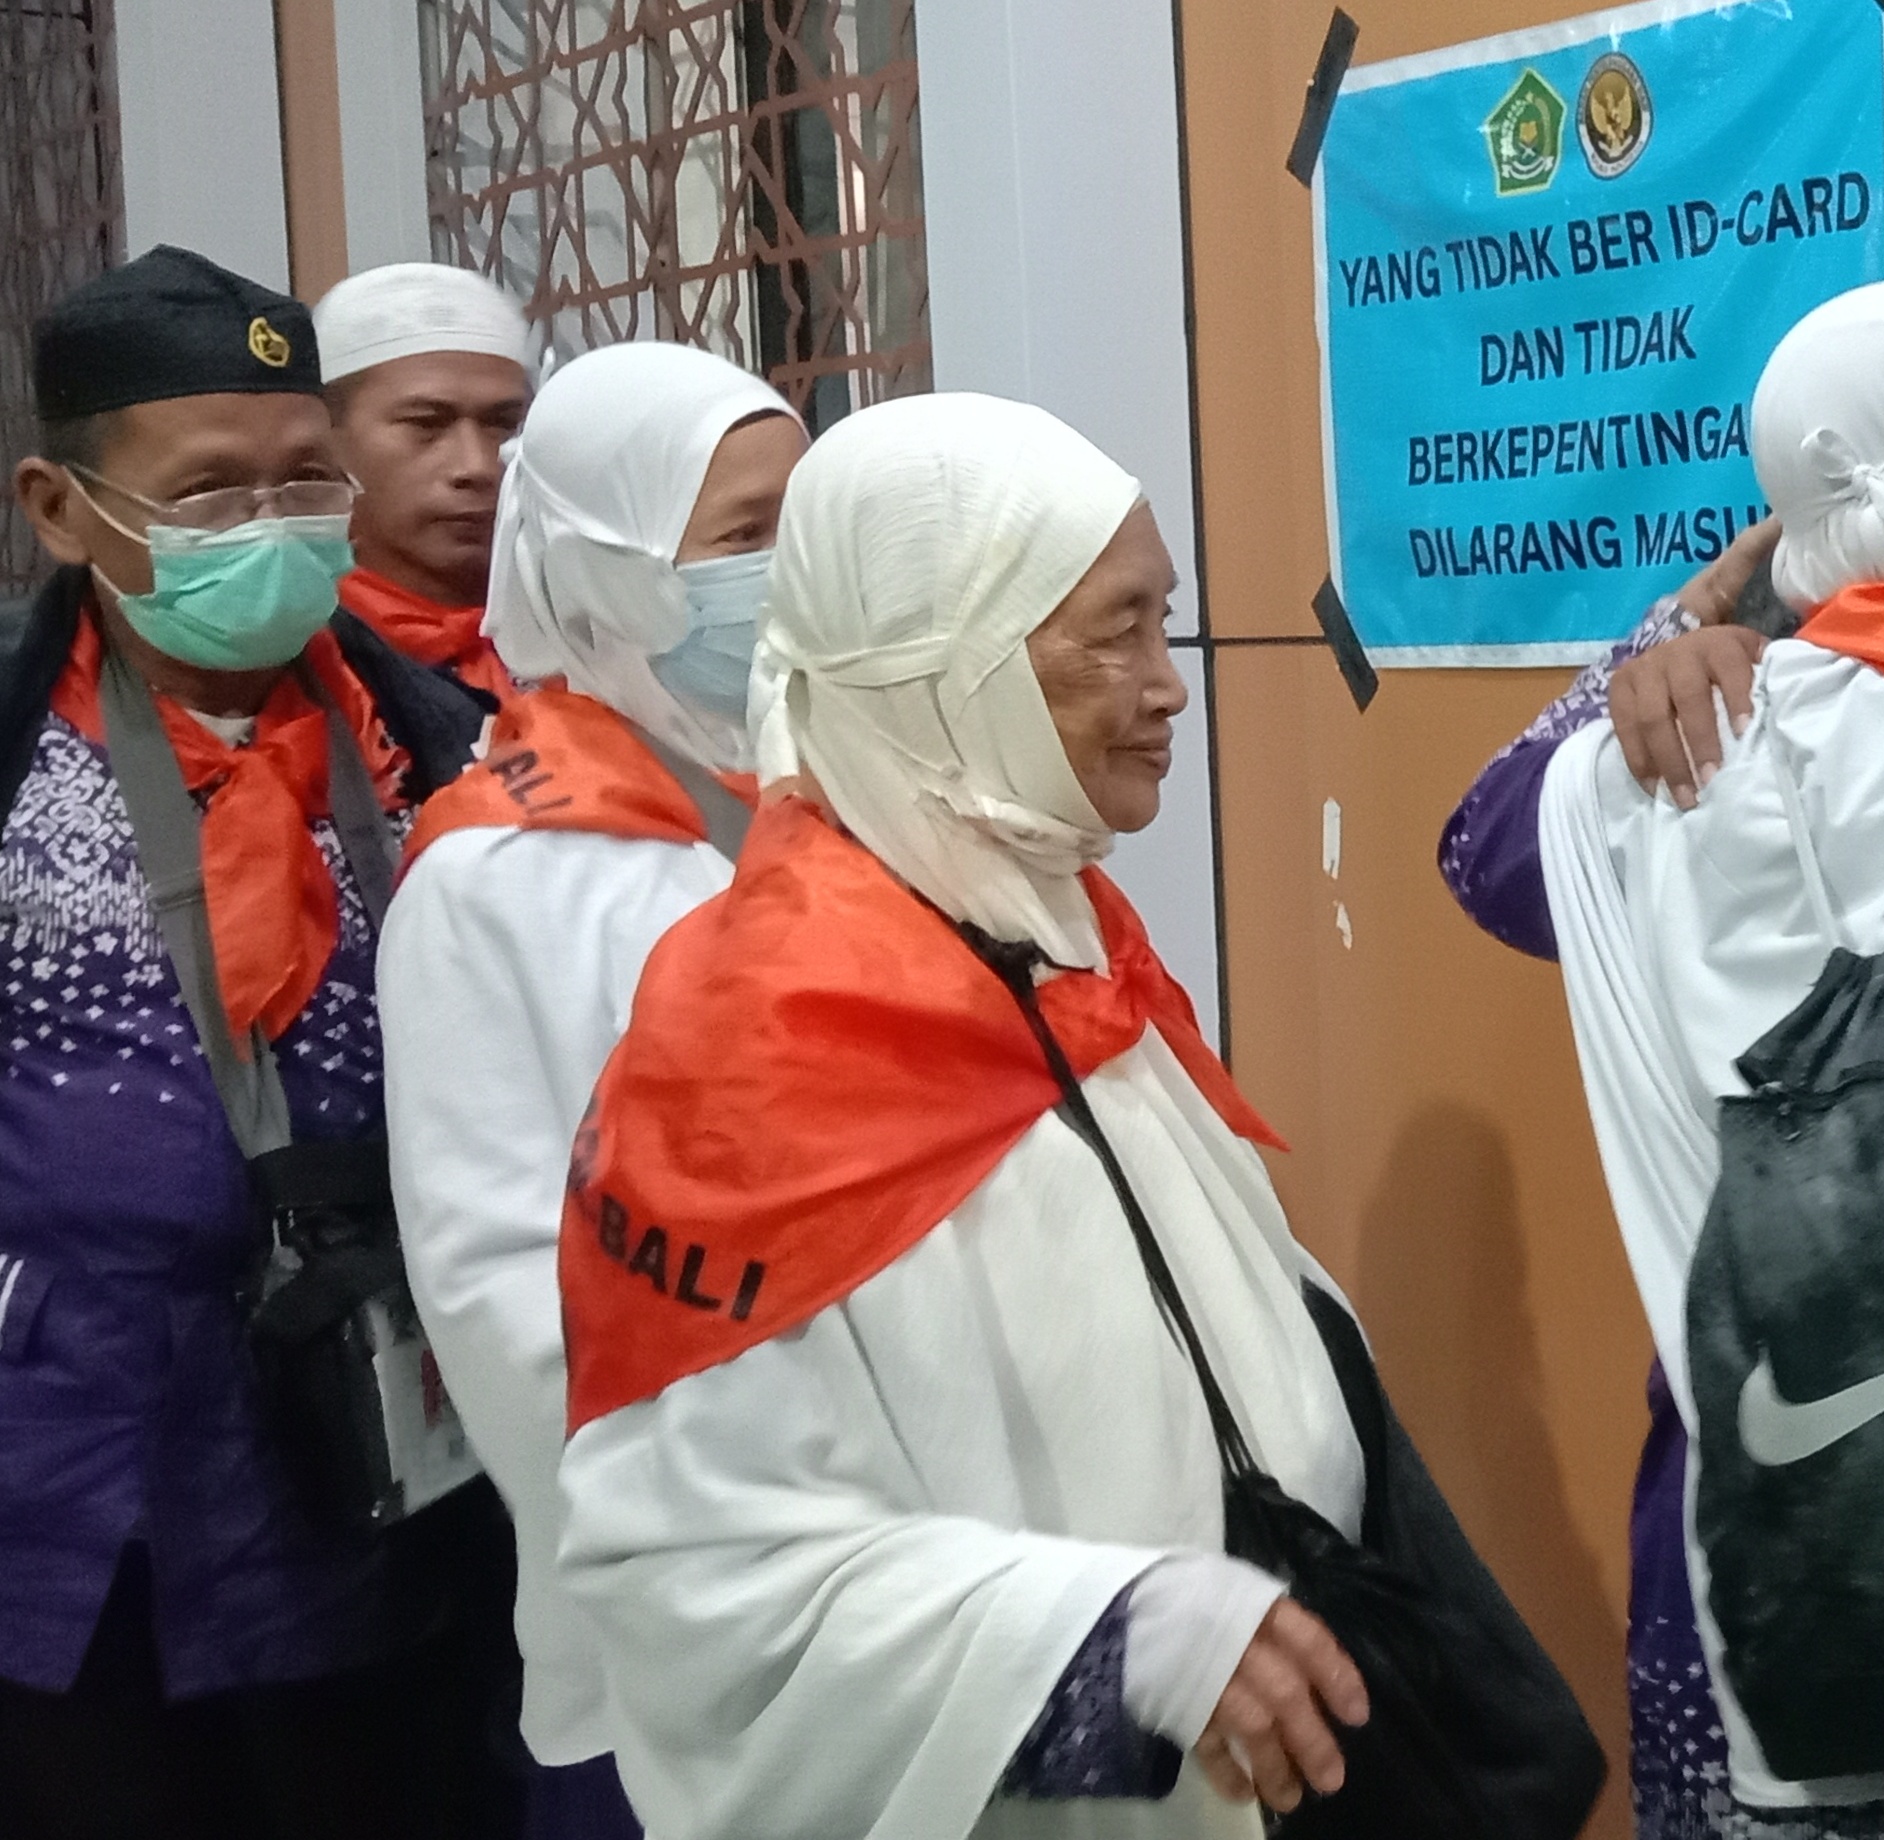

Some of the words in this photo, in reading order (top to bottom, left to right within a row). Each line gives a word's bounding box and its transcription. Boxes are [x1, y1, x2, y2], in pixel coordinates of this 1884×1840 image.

[1339, 244, 1442, 308] YANG
[1446, 225, 1560, 293] TIDAK
[1568, 209, 1658, 275] BER
[1670, 171, 1871, 261] ID-CARD
[1480, 327, 1565, 387] DAN
[1575, 304, 1697, 376] TIDAK
[1407, 403, 1750, 486] BERKEPENTINGA
[1408, 516, 1623, 578] DILARANG
[489, 749, 573, 815] ALI
[596, 1193, 766, 1322] BALI
